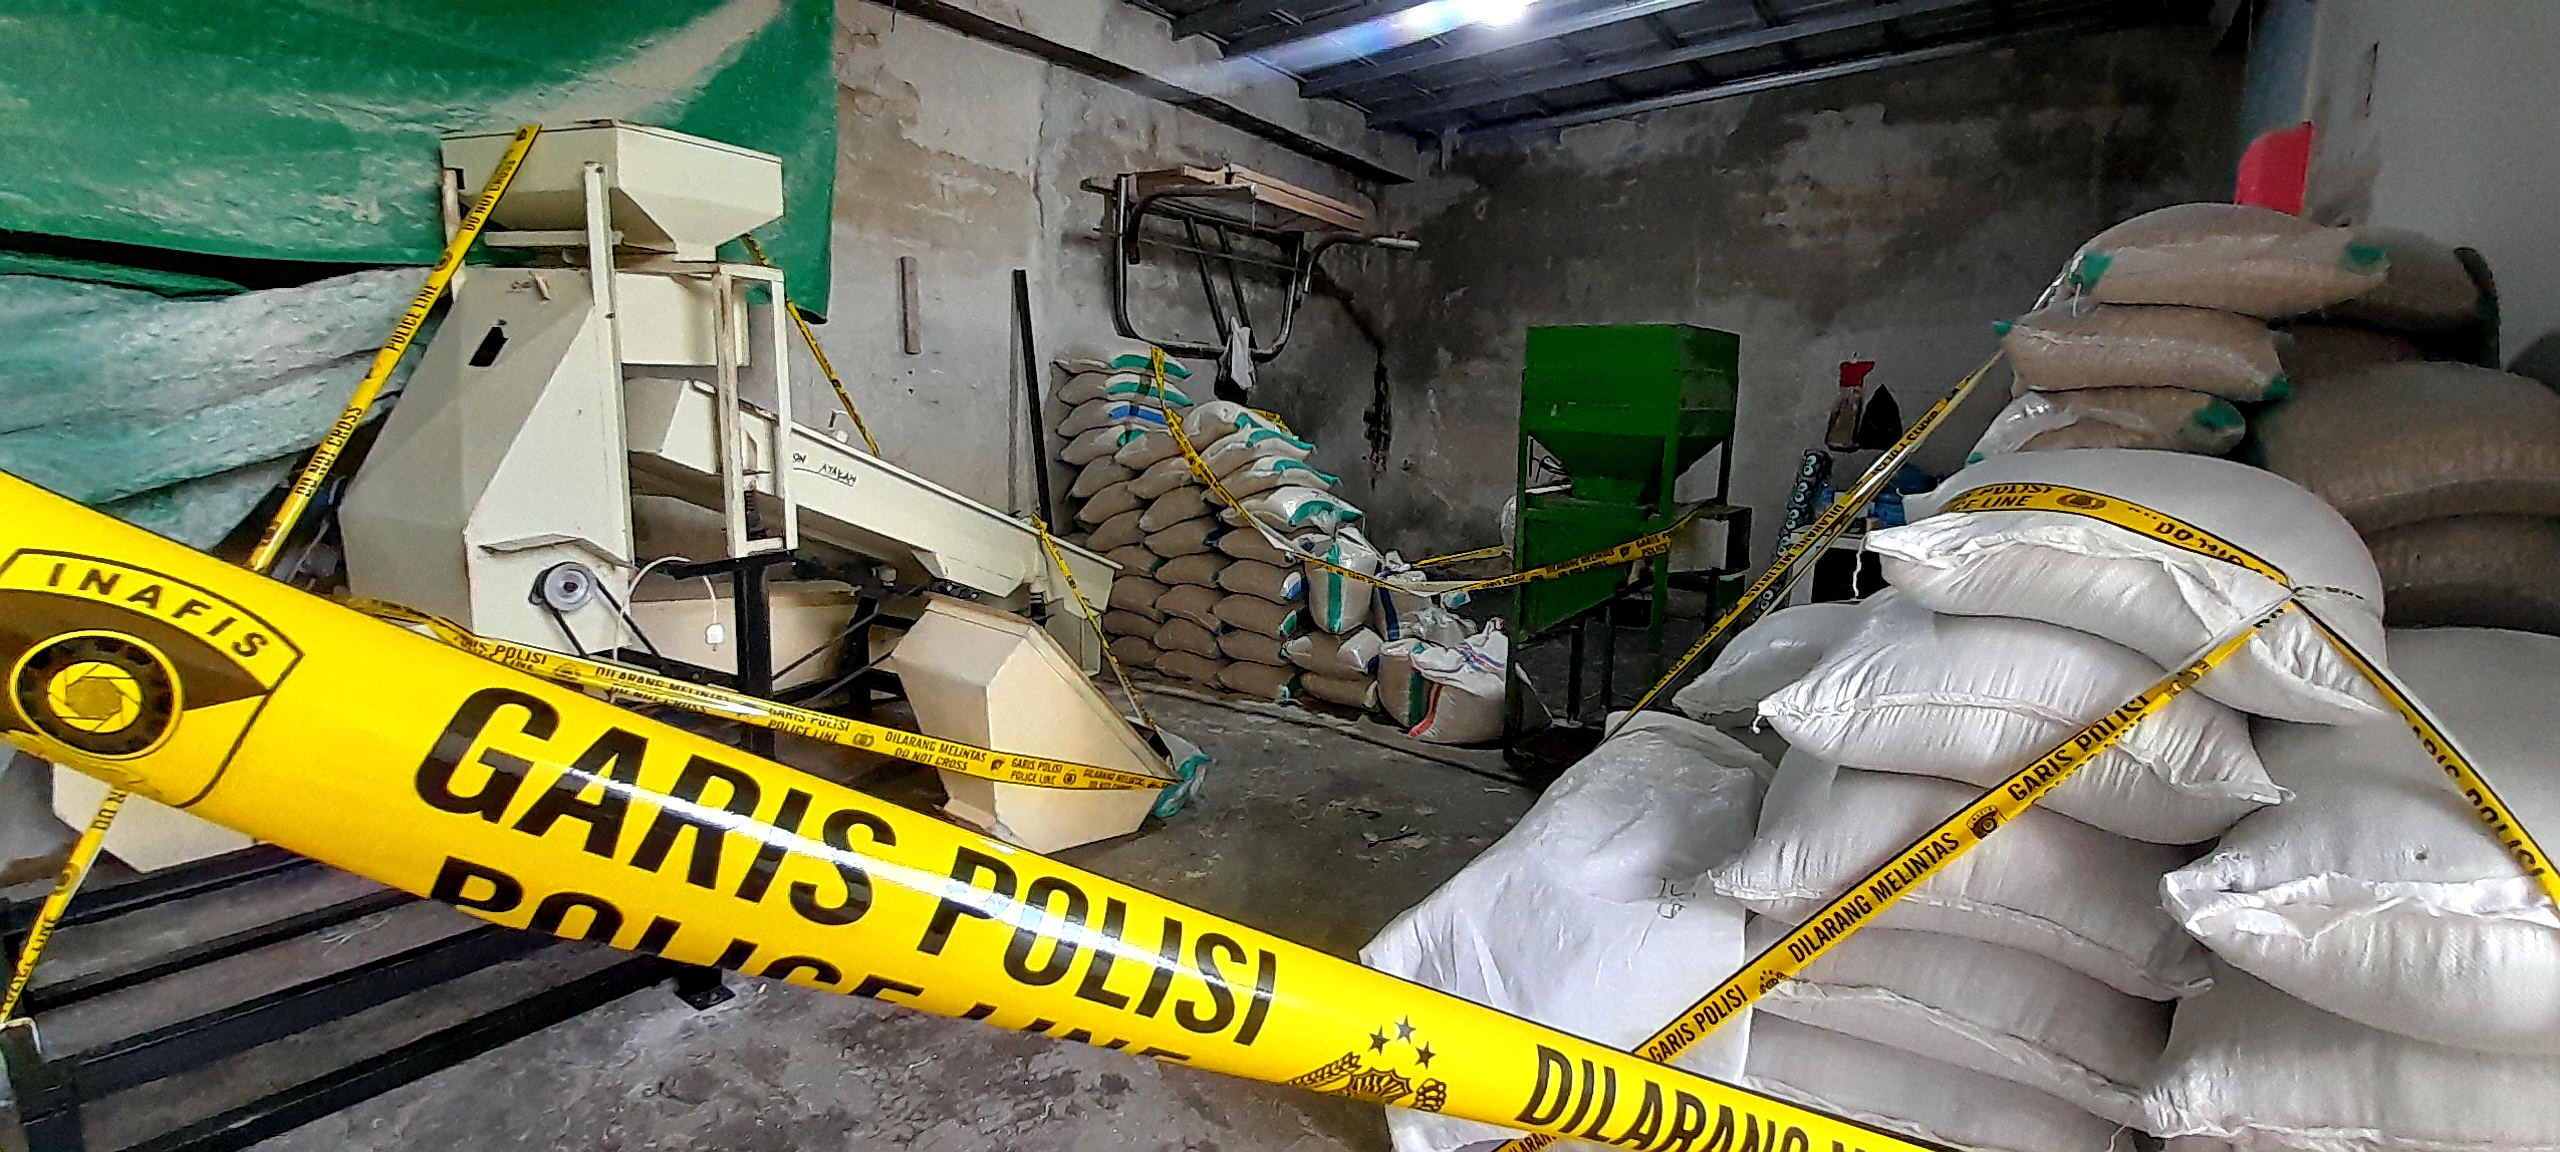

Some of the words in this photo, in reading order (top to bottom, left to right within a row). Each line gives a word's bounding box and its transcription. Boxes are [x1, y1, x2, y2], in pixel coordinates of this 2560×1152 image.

[384, 312, 423, 352] POLICE
[413, 284, 441, 313] LINE
[326, 406, 363, 448] CROSS
[1980, 496, 2034, 508] LINE
[2154, 521, 2195, 541] DO
[47, 563, 269, 658] INAFIS
[490, 644, 548, 666] POLISI
[768, 719, 810, 738] POLICE
[885, 731, 937, 751] DILARANG
[938, 742, 988, 763] MELINTAS
[894, 747, 911, 759] DO
[912, 751, 933, 764] NOT
[934, 756, 969, 771] CROSS
[2007, 748, 2074, 802] GARIS
[2074, 694, 2150, 753] POLISI
[1010, 772, 1037, 784] POLICE
[1011, 757, 1036, 770] GARIS
[414, 686, 897, 926] GARIS
[917, 845, 1277, 1047] POLISI
[1787, 893, 1874, 964] DILARANG
[1868, 831, 1961, 904] MELINTAS
[1647, 1022, 1697, 1064] GARIS
[1691, 983, 1749, 1033] POLISI
